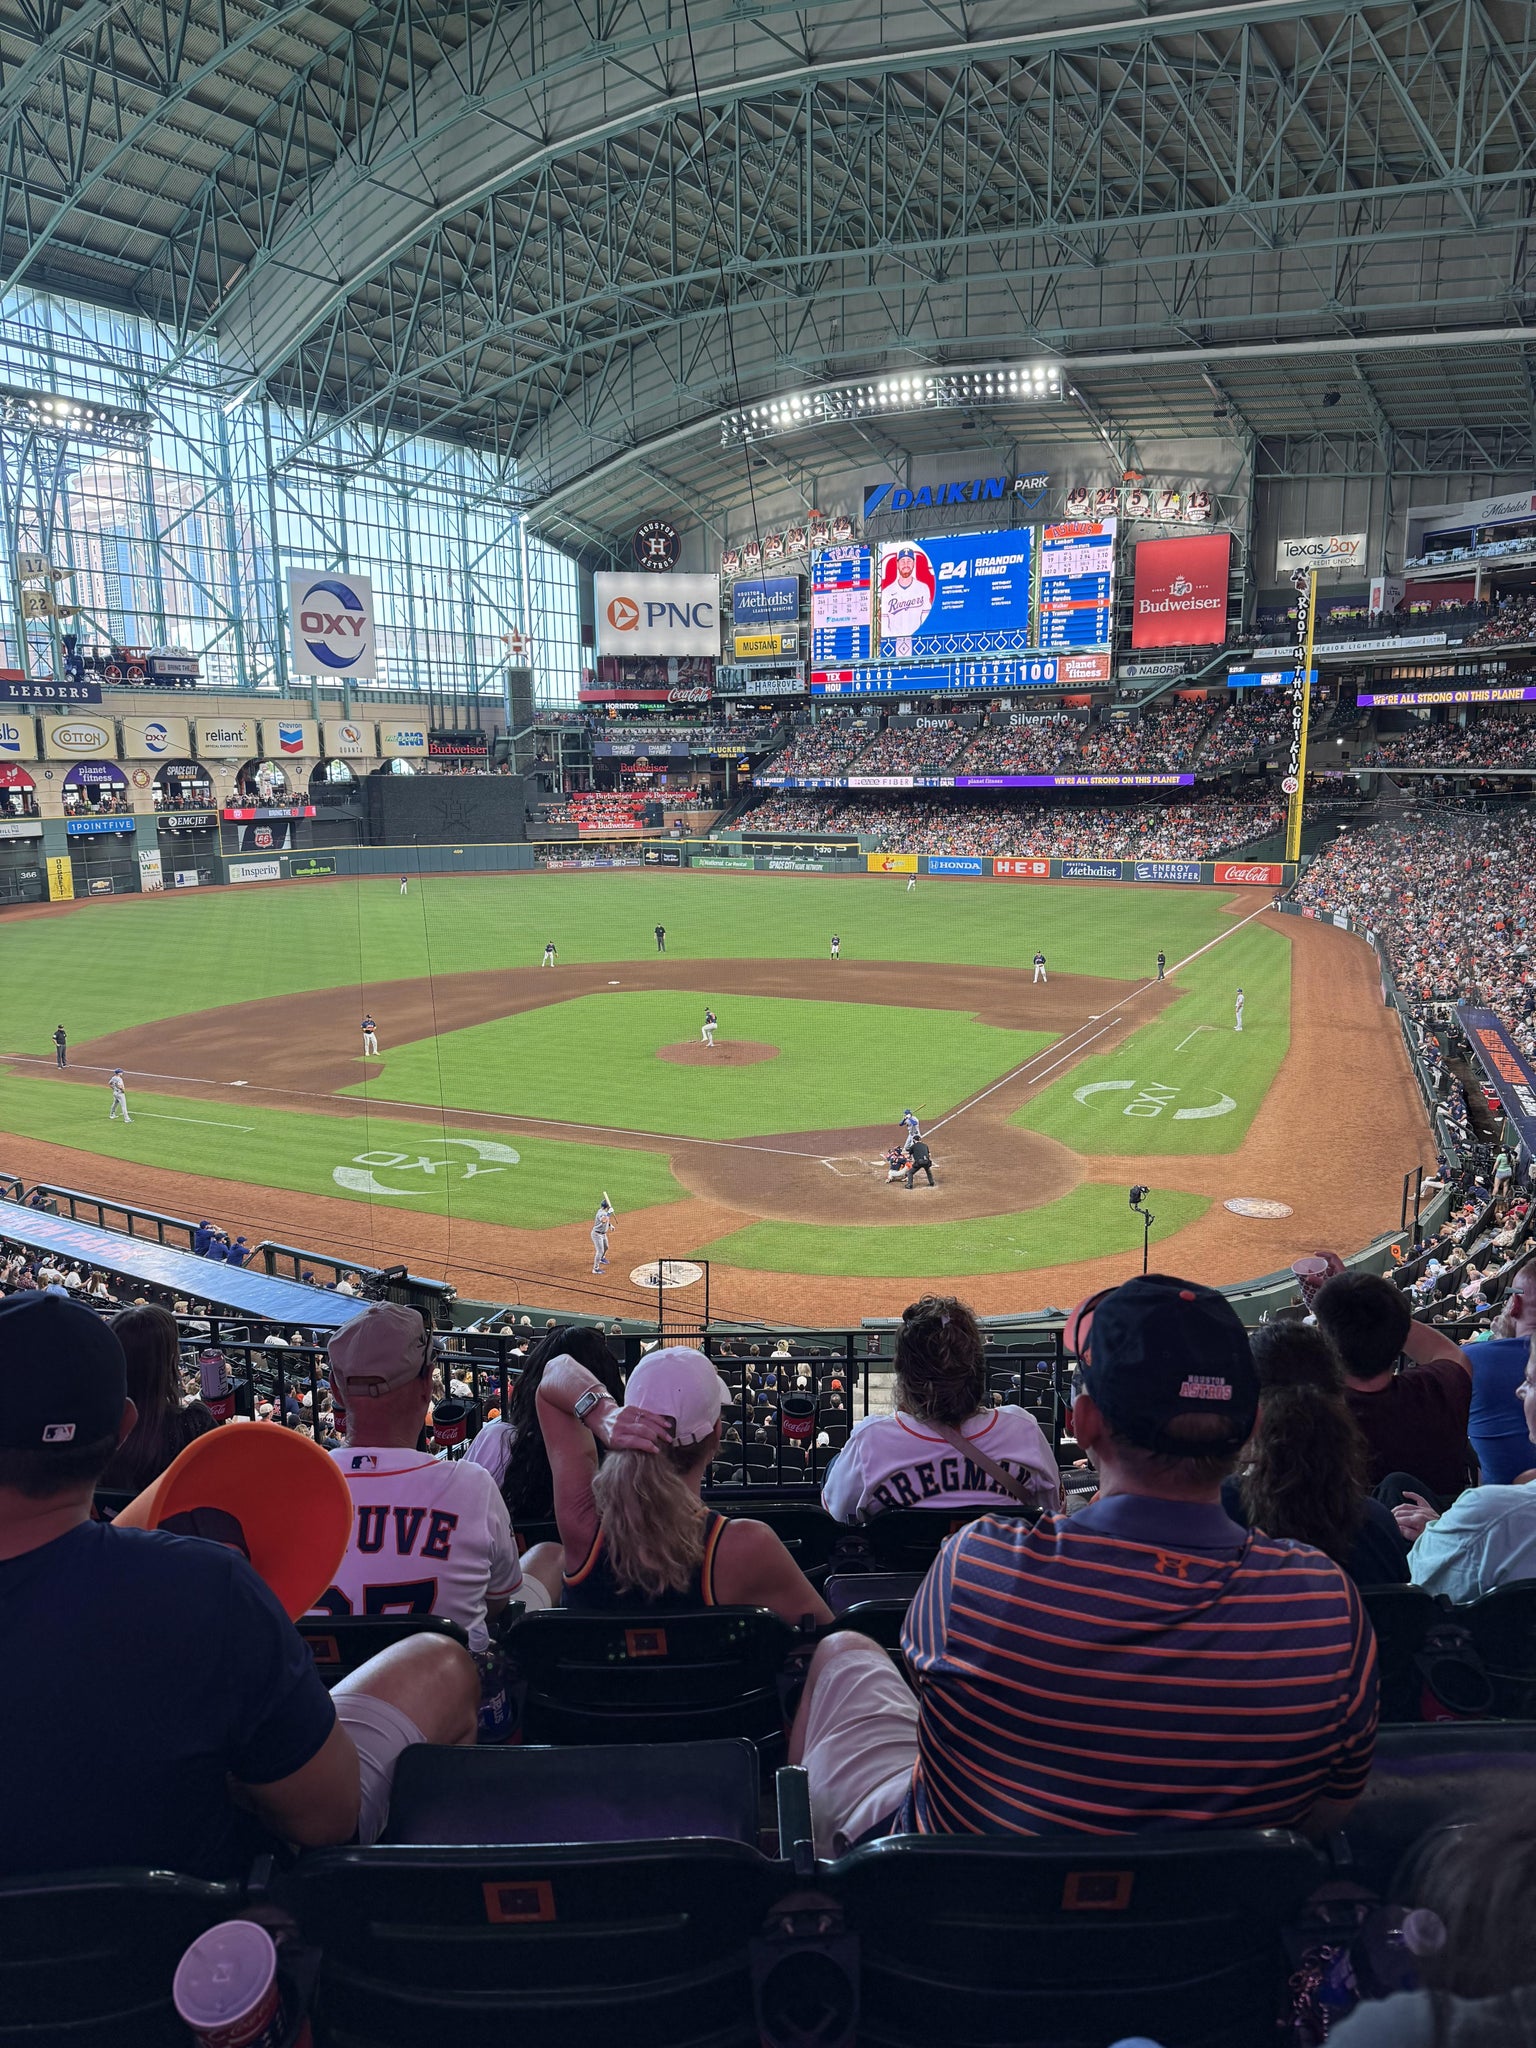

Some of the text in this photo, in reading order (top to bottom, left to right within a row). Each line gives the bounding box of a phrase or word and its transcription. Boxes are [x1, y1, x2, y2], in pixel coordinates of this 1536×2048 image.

[891, 476, 1050, 511] DAIKIN PARK
[1067, 487, 1087, 504] 49
[1096, 487, 1117, 505] 24
[1131, 489, 1141, 505] 5
[1162, 490, 1173, 507] 7
[1188, 491, 1209, 509] 13
[1481, 500, 1529, 519] Michelob
[638, 522, 675, 537] HOUSTON
[810, 521, 826, 537] 34
[833, 516, 849, 531] 42
[1053, 521, 1094, 538] ASTROS
[765, 535, 780, 549] 25
[788, 528, 803, 543] 33
[649, 537, 667, 555] H
[743, 542, 758, 556] 40
[1284, 537, 1360, 558] Texas Bay
[723, 550, 737, 564] 32
[828, 547, 861, 560] TEXAS
[25, 559, 43, 572] 17
[641, 557, 674, 569] ASTROS
[938, 554, 1024, 580] 24 BRANDON
[1309, 557, 1357, 567] CREDIT UNION
[974, 565, 1007, 577] NIMMO
[29, 598, 47, 611] 22
[738, 591, 794, 609] Methodist
[888, 596, 924, 613] Rangers
[644, 601, 714, 629] PNC
[300, 611, 367, 637] OXY
[742, 638, 796, 651] MUSTANG CAT
[1311, 640, 1397, 653] UPERIOR LIGHT BEER
[1065, 660, 1097, 671] planet
[825, 664, 1011, 682] TEX 0 0 0 0 0 0 0 0 4
[1068, 667, 1102, 679] fitness
[754, 680, 798, 692] HARGROVE
[825, 683, 841, 692] HOU
[855, 682, 861, 690] 0
[866, 682, 871, 690] 0
[886, 681, 892, 689] 2
[955, 678, 960, 686] 3
[982, 676, 987, 684] 0
[993, 675, 998, 683] 2
[1004, 675, 1010, 683] 4
[1287, 596, 1308, 775] ROOT 4 THA CHIKIN
[9, 685, 89, 698] LEADERS
[1373, 689, 1525, 705] WE'RE ALL STRONG ON THIS PLANET
[278, 721, 302, 729] Chevron
[916, 717, 951, 729] Chevy
[1009, 712, 1069, 726] Silverado
[59, 729, 101, 746] COTTON
[145, 733, 168, 741] OXY
[205, 728, 244, 742] reliant
[397, 731, 423, 747] LNG
[340, 746, 363, 754] QUANTA
[429, 743, 488, 755] Budweiser
[708, 746, 746, 754] PLUCKERS
[79, 765, 106, 775] planet
[167, 765, 199, 776] SPACE CITY
[82, 774, 113, 783] fitness
[1054, 777, 1075, 785] WE'RE
[1090, 776, 1121, 784] STRONG
[1121, 776, 1135, 784] ON
[1135, 776, 1152, 784] THIS
[1152, 775, 1181, 784] PLANET
[71, 820, 131, 831] 1POINTFIVE
[177, 816, 208, 827] EMCJET
[598, 821, 636, 829] Budweiser
[258, 834, 269, 843] 66
[819, 846, 832, 854] 370
[241, 863, 279, 877] Insperity
[768, 860, 783, 870] SPACE
[783, 860, 795, 870] CITY
[940, 862, 980, 870] HONDA
[1066, 866, 1117, 877] Methodist
[1152, 864, 1190, 872] ENERGY
[20, 871, 37, 879] 366
[1152, 871, 1199, 880] TRANSFER
[1122, 1081, 1181, 1118] OXY
[352, 1150, 508, 1179] OXY
[1187, 1374, 1226, 1384] HOUSTON
[1179, 1381, 1233, 1400] ASTROS
